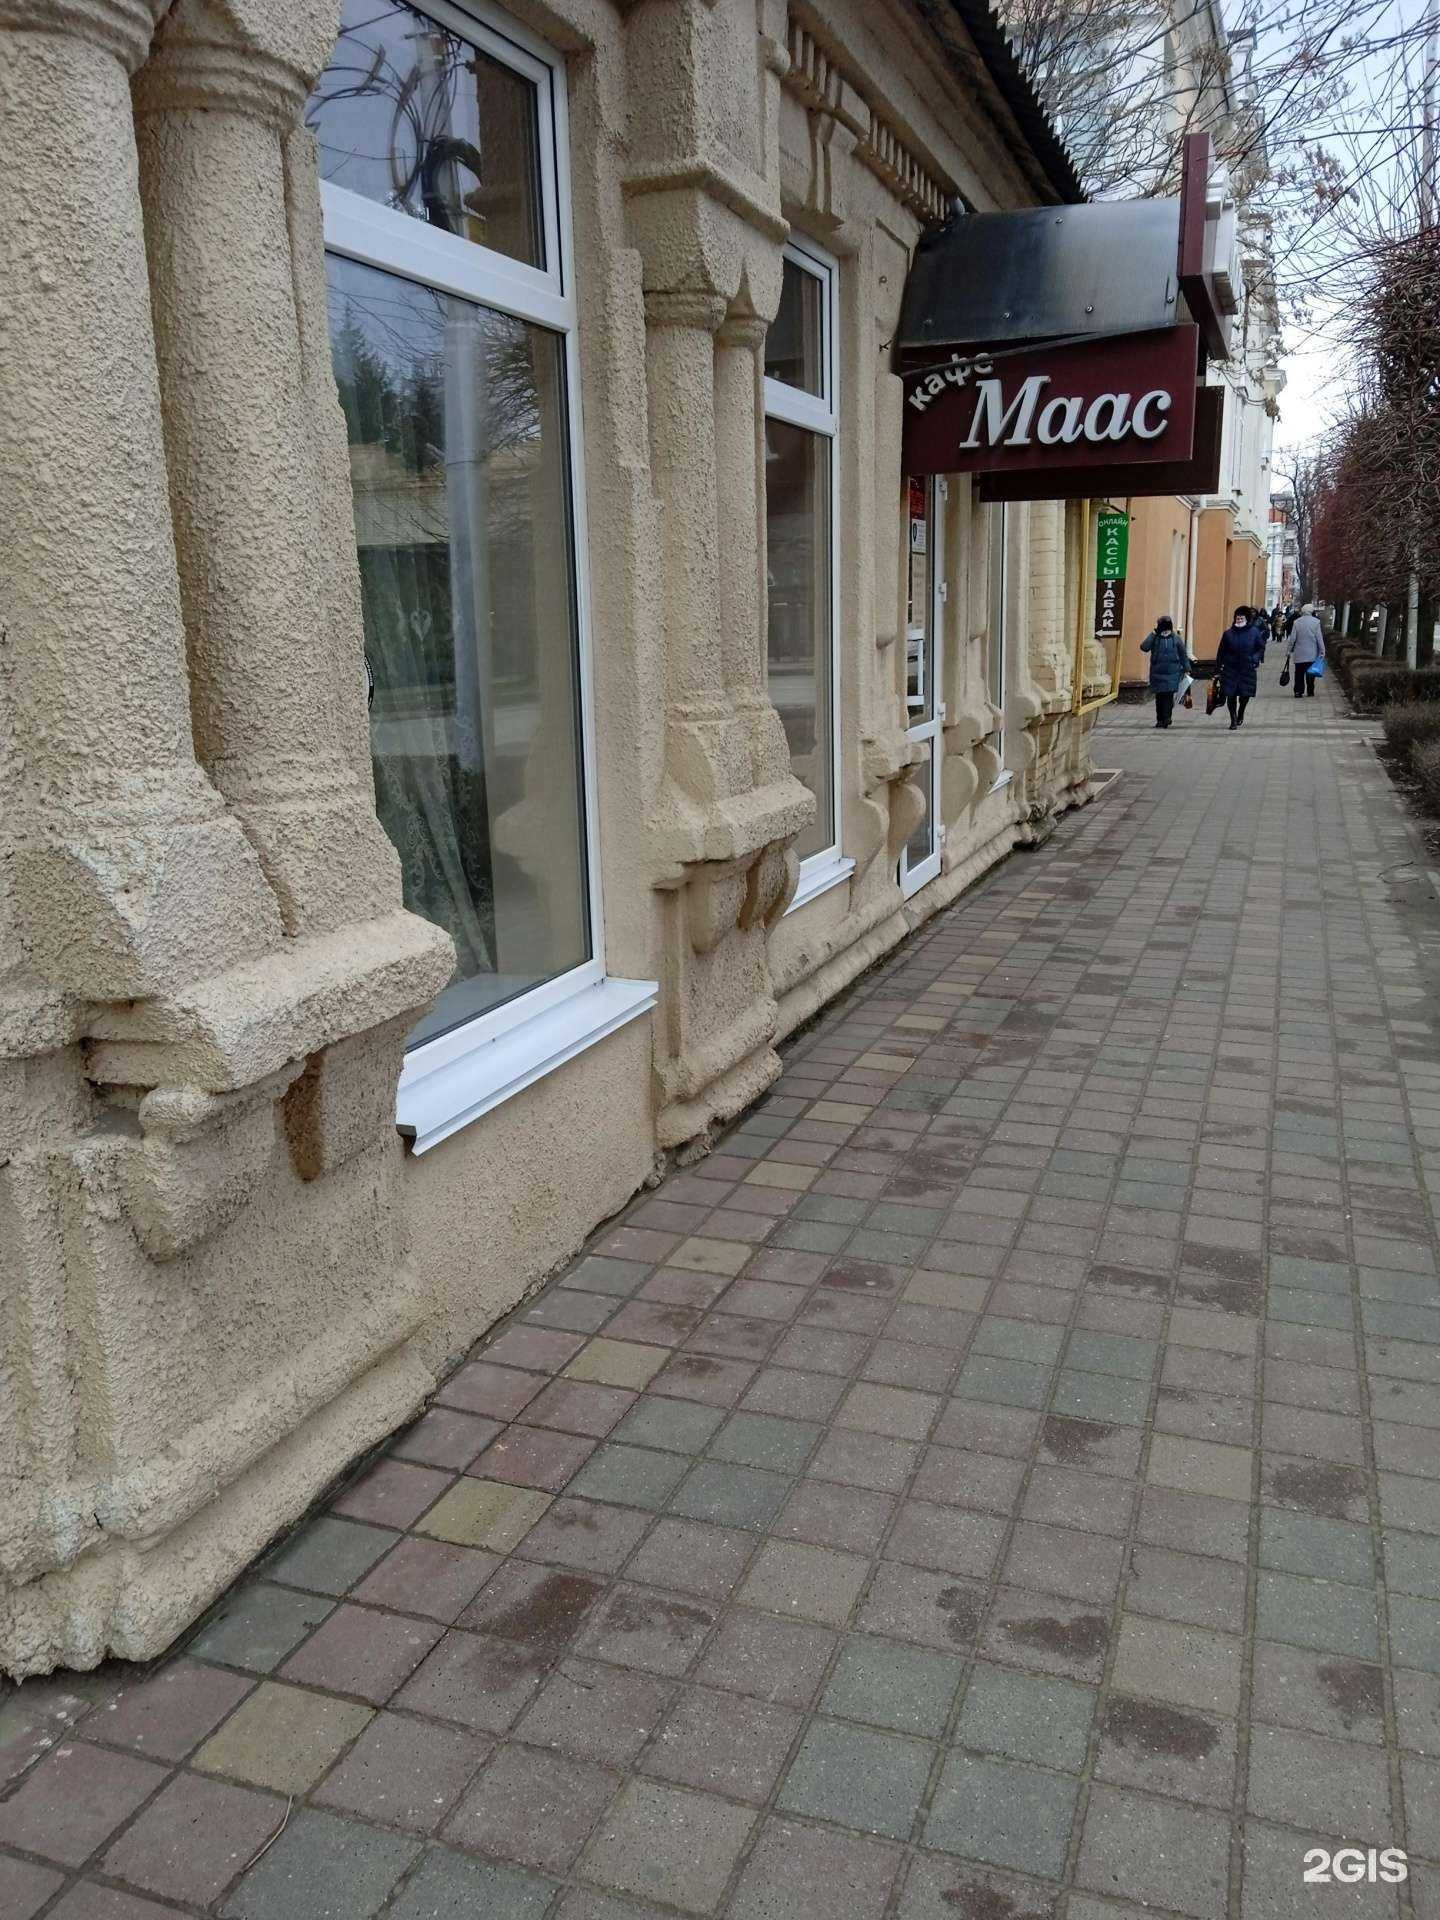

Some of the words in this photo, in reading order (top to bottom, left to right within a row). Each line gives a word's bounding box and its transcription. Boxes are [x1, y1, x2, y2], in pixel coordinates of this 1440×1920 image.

[908, 352, 993, 411] кафе
[959, 375, 1172, 448] Маас
[1103, 528, 1120, 575] КАССЫ
[1102, 579, 1116, 628] ТАБАК
